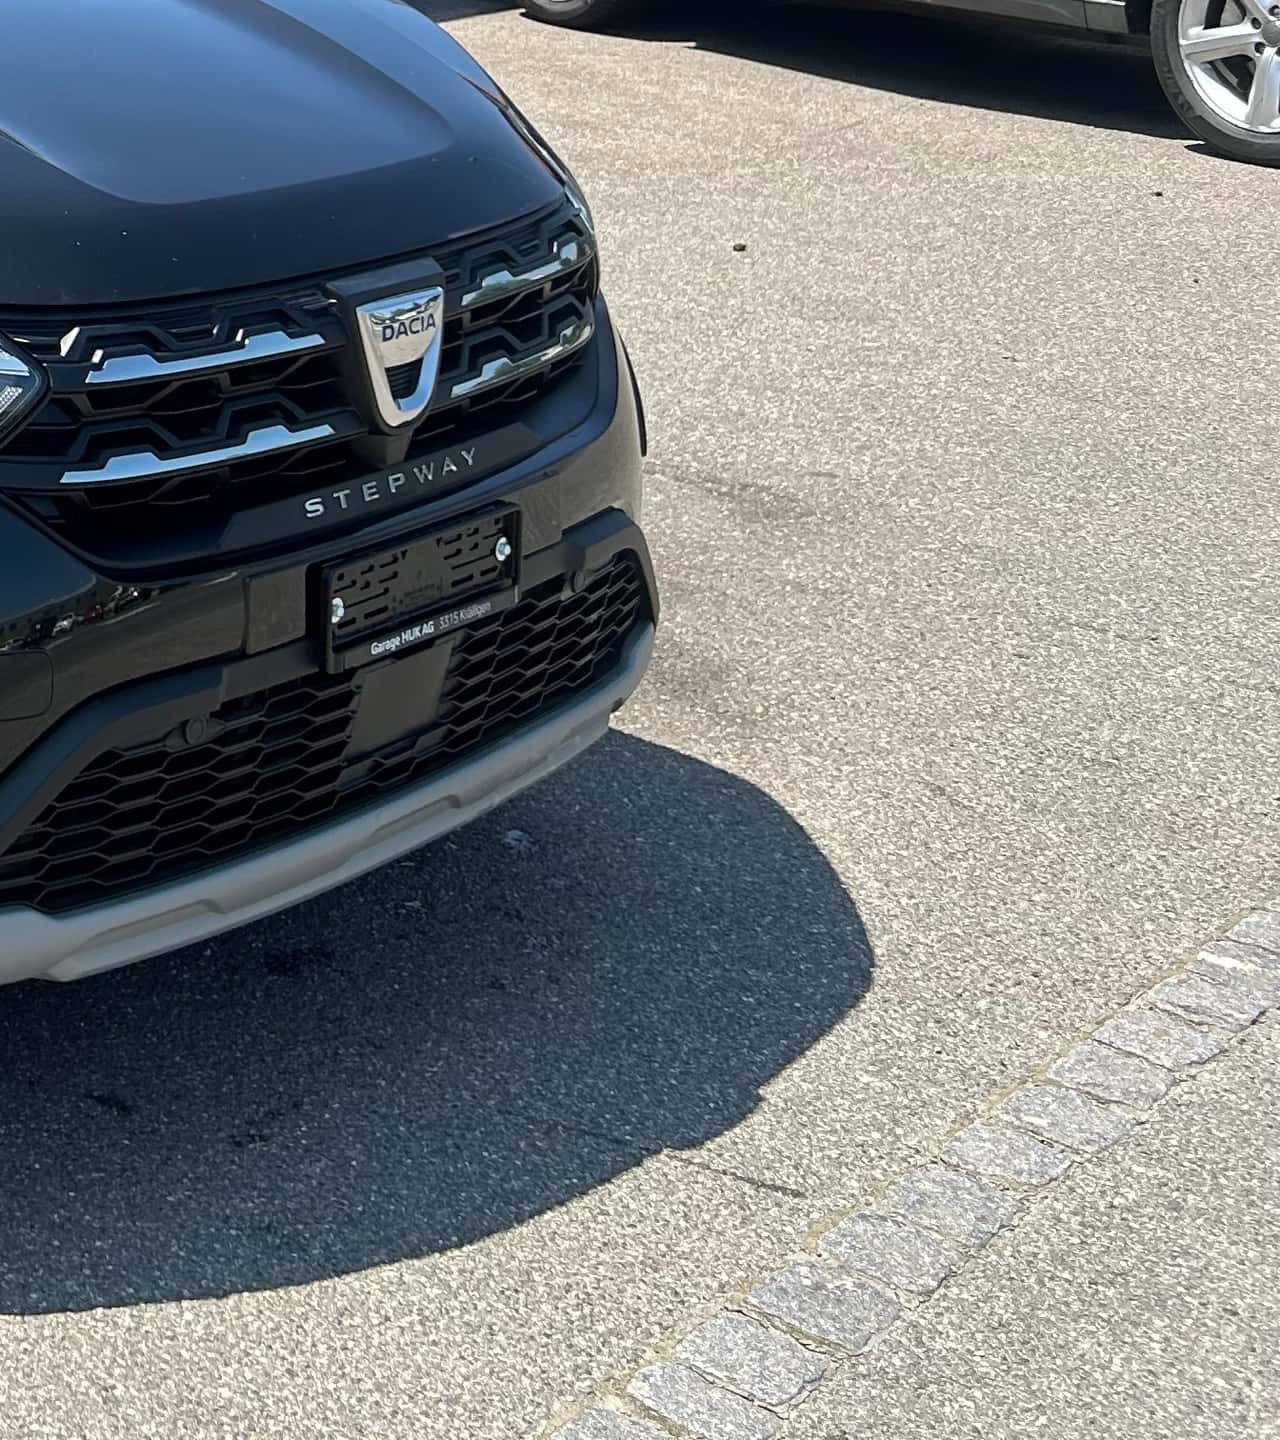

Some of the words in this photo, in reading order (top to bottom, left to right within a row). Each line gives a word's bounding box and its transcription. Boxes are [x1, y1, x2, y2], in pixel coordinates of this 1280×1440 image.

[382, 313, 436, 342] DACIA
[304, 447, 477, 518] STEPWAY
[371, 636, 401, 655] Garage
[401, 626, 422, 643] HUK
[421, 620, 435, 636] AG
